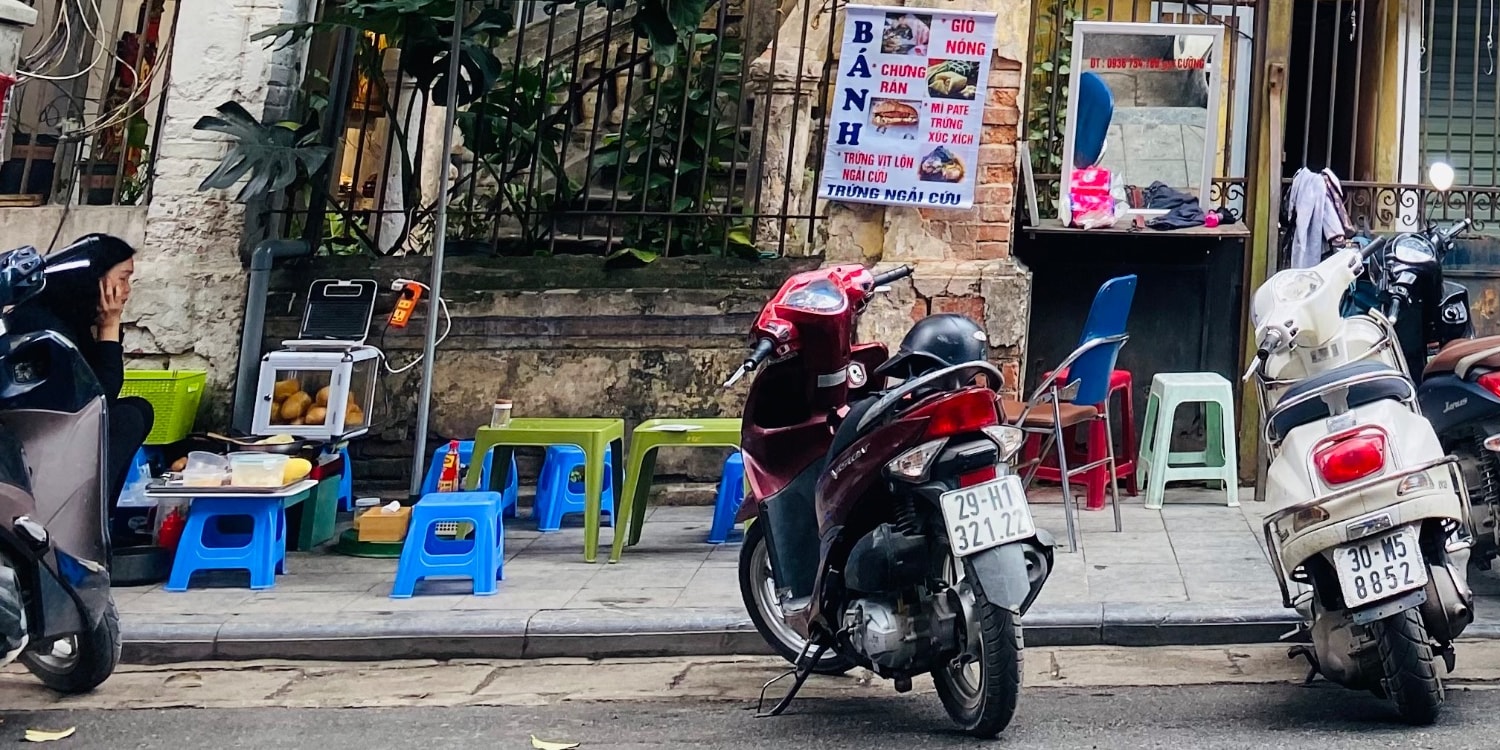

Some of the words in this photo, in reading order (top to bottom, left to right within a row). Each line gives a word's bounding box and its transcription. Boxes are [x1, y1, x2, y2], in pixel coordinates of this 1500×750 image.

[945, 38, 986, 56] NÓNG
[881, 63, 927, 79] CHƯNG
[836, 20, 873, 146] BÁNH
[880, 79, 908, 94] RÁN
[947, 104, 969, 116] PATE
[931, 116, 964, 130] TRỨNG
[928, 130, 949, 143] XÚC
[951, 132, 974, 145] XÍCH
[844, 151, 875, 166] TRỨNG
[878, 154, 892, 169] VỊT
[895, 153, 914, 171] LỘN
[842, 166, 865, 182] NGẢI
[868, 169, 888, 183] CỨU
[827, 183, 880, 199] TRỨNG
[884, 186, 924, 203] NGẢI
[928, 190, 962, 206] CỨU
[953, 482, 1013, 521] 29-H1
[954, 508, 1028, 551] 321.22
[1347, 533, 1407, 573] 30-M5
[1354, 561, 1414, 600] 8852
